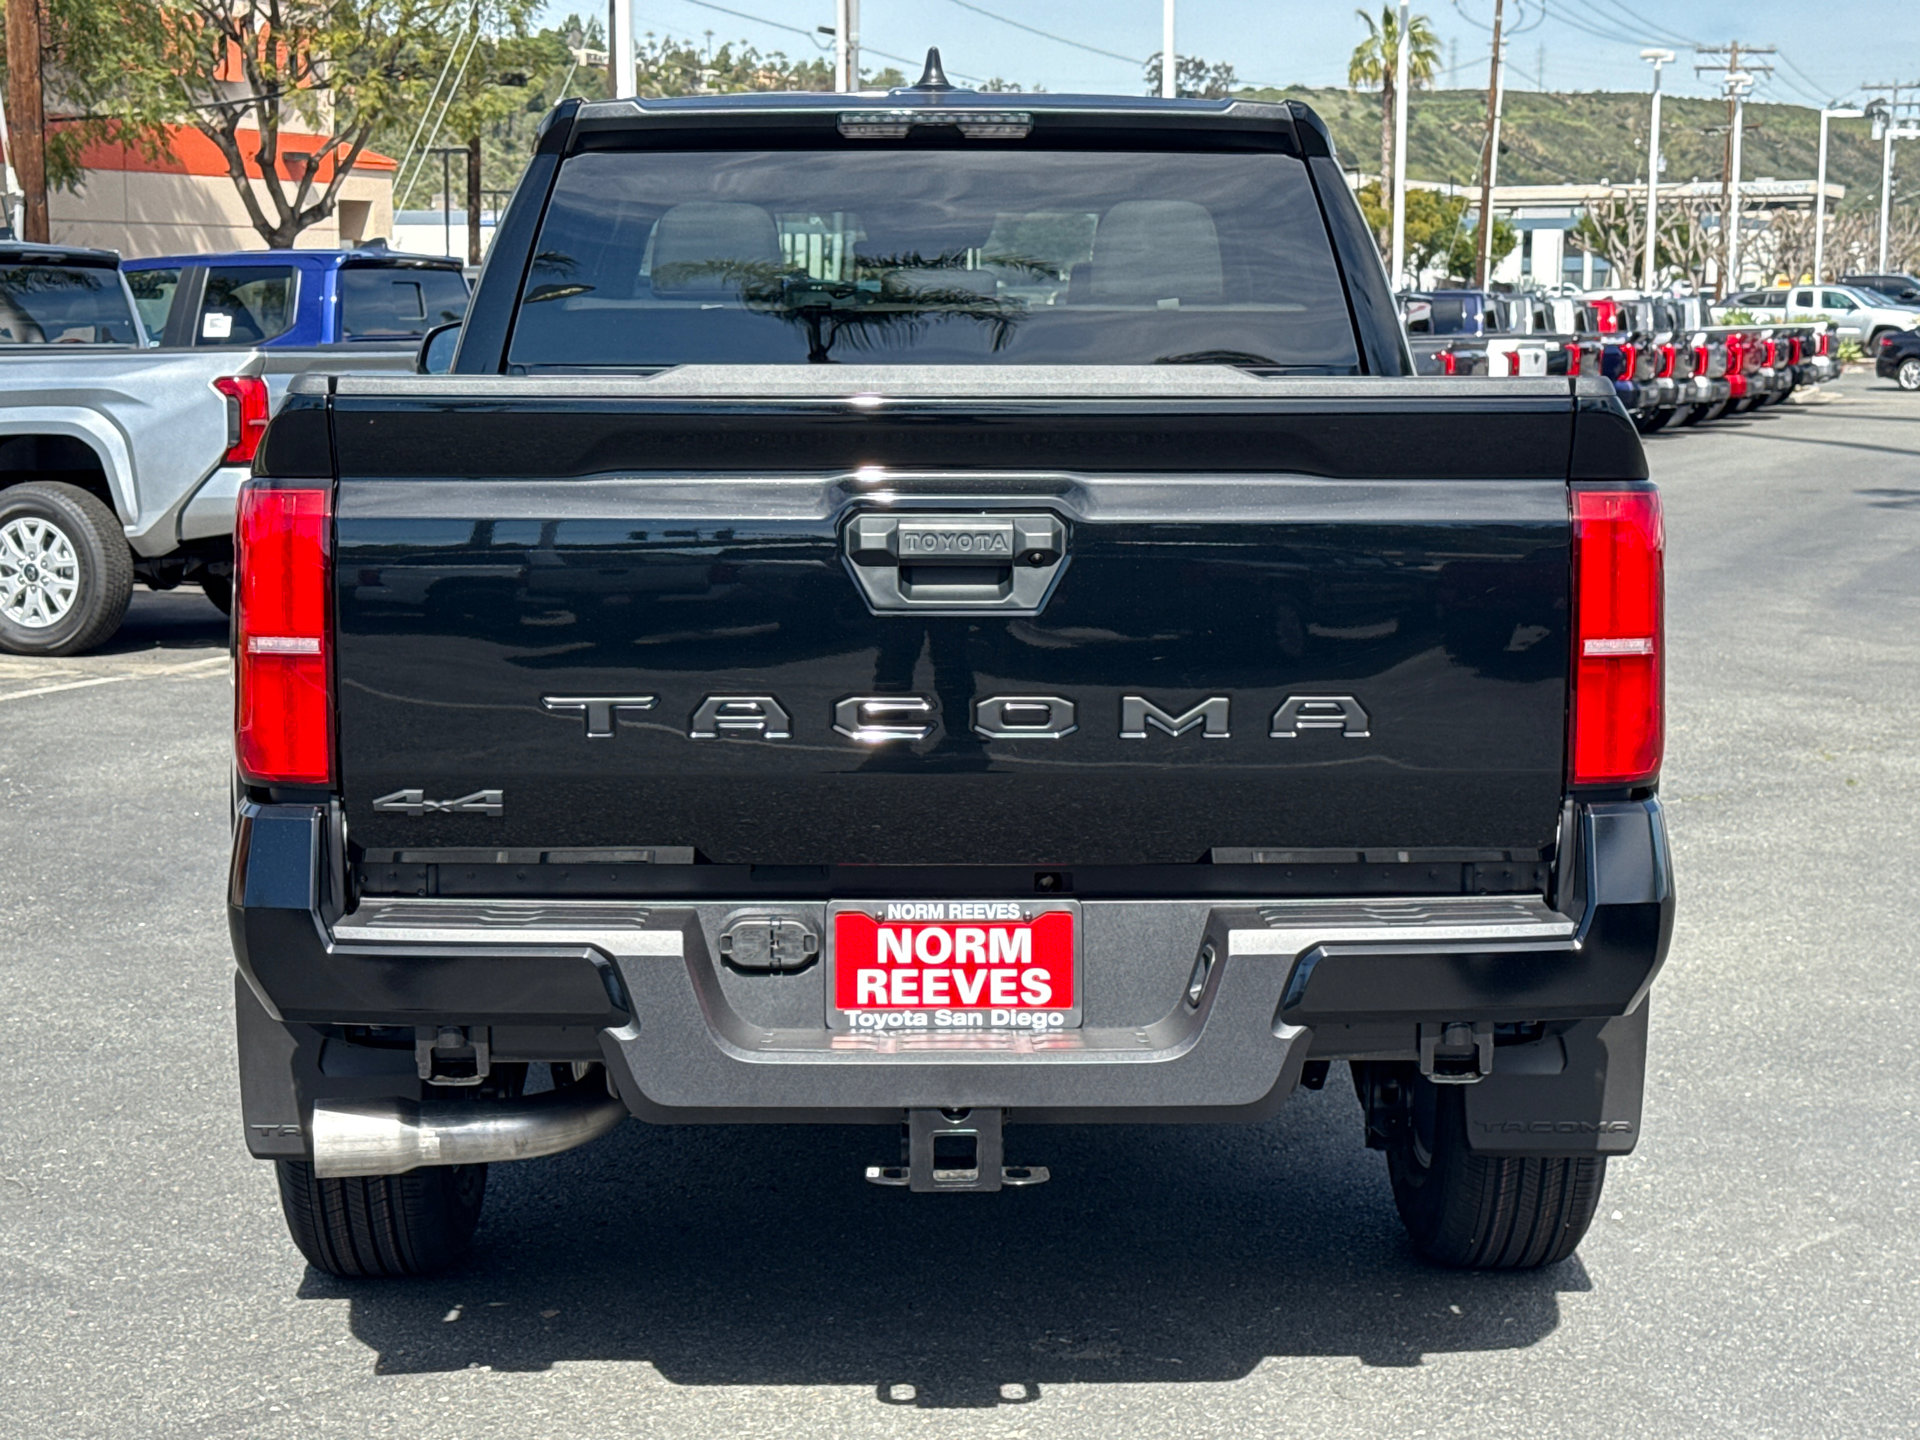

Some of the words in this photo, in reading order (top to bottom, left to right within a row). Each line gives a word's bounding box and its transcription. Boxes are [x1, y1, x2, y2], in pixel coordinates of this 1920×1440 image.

[905, 532, 1009, 552] TOYOTA
[541, 694, 1371, 739] TACOMA
[372, 789, 504, 817] 4x4
[887, 903, 945, 920] NORM
[950, 903, 1021, 920] REEVES
[877, 927, 1032, 964] NORM
[856, 968, 1053, 1005] REEVES
[844, 1009, 928, 1030] Toyota
[934, 1009, 983, 1027] San
[991, 1009, 1065, 1030] Diego
[1474, 1120, 1634, 1135] TACOMA
